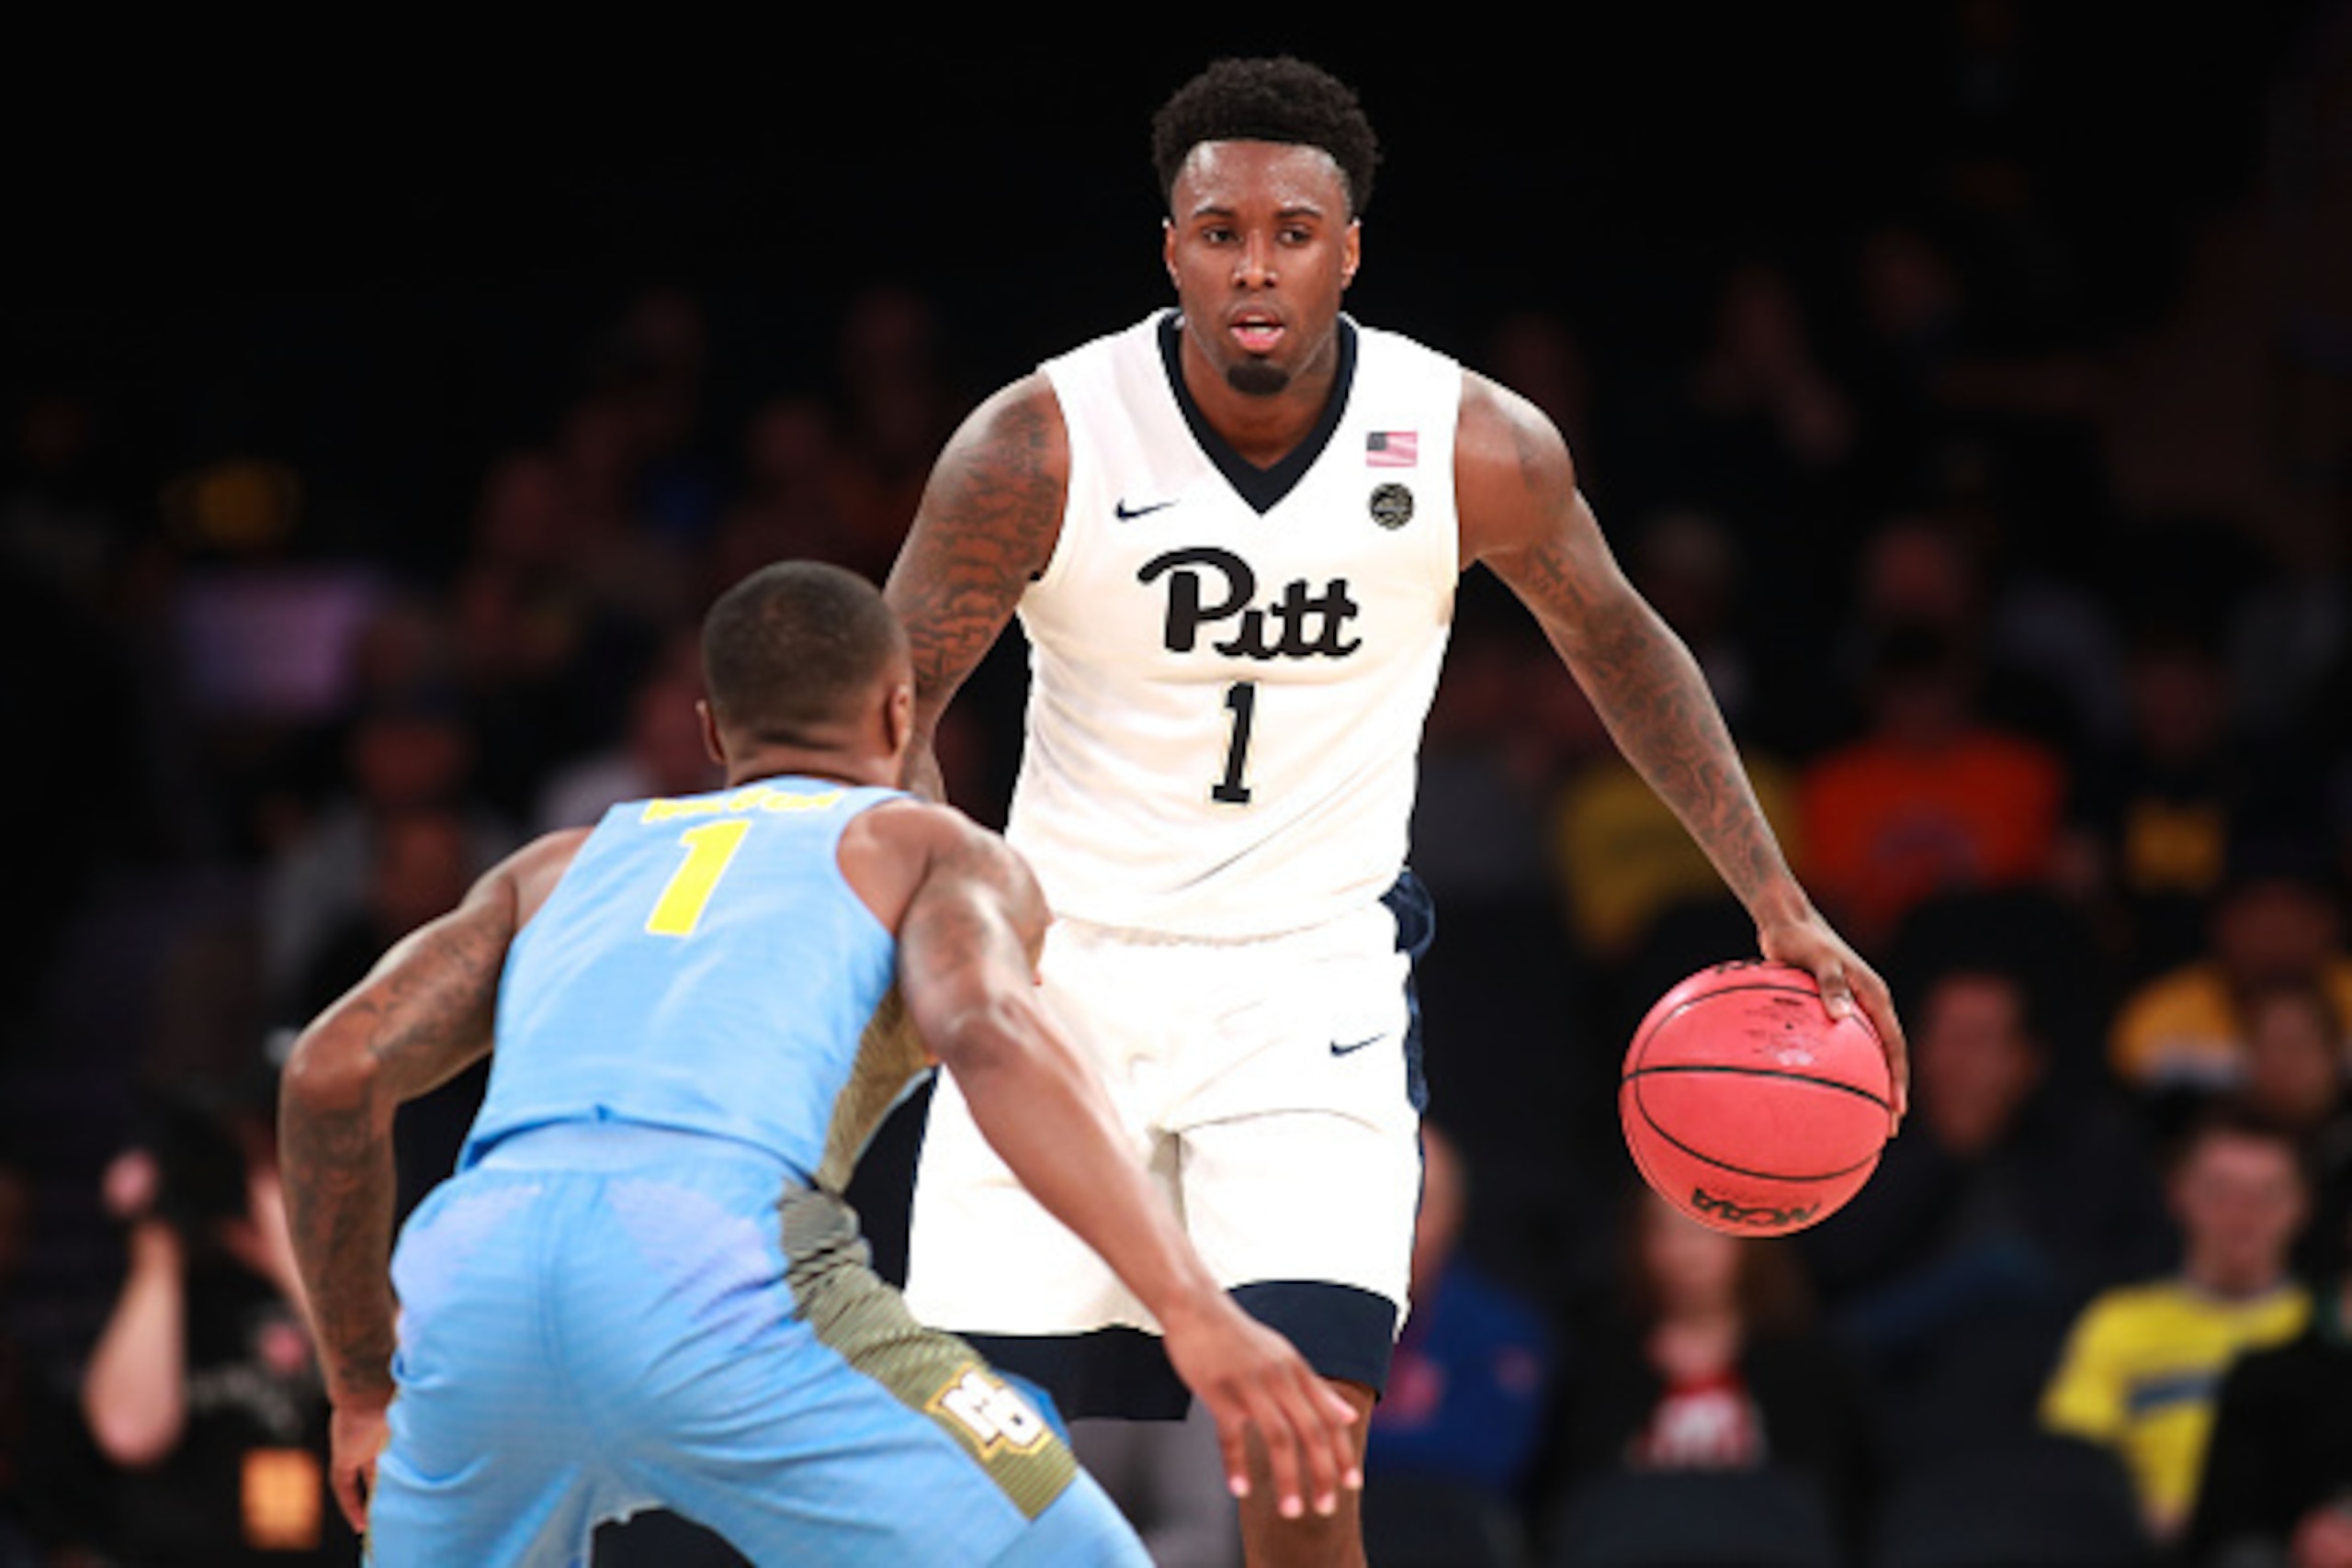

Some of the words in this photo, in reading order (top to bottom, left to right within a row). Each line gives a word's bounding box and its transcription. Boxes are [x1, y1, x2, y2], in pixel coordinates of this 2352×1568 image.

[1137, 547, 1363, 660] Pitt
[1211, 682, 1256, 805] 1
[645, 818, 752, 936] 1
[1690, 1187, 1823, 1228] NCAA
